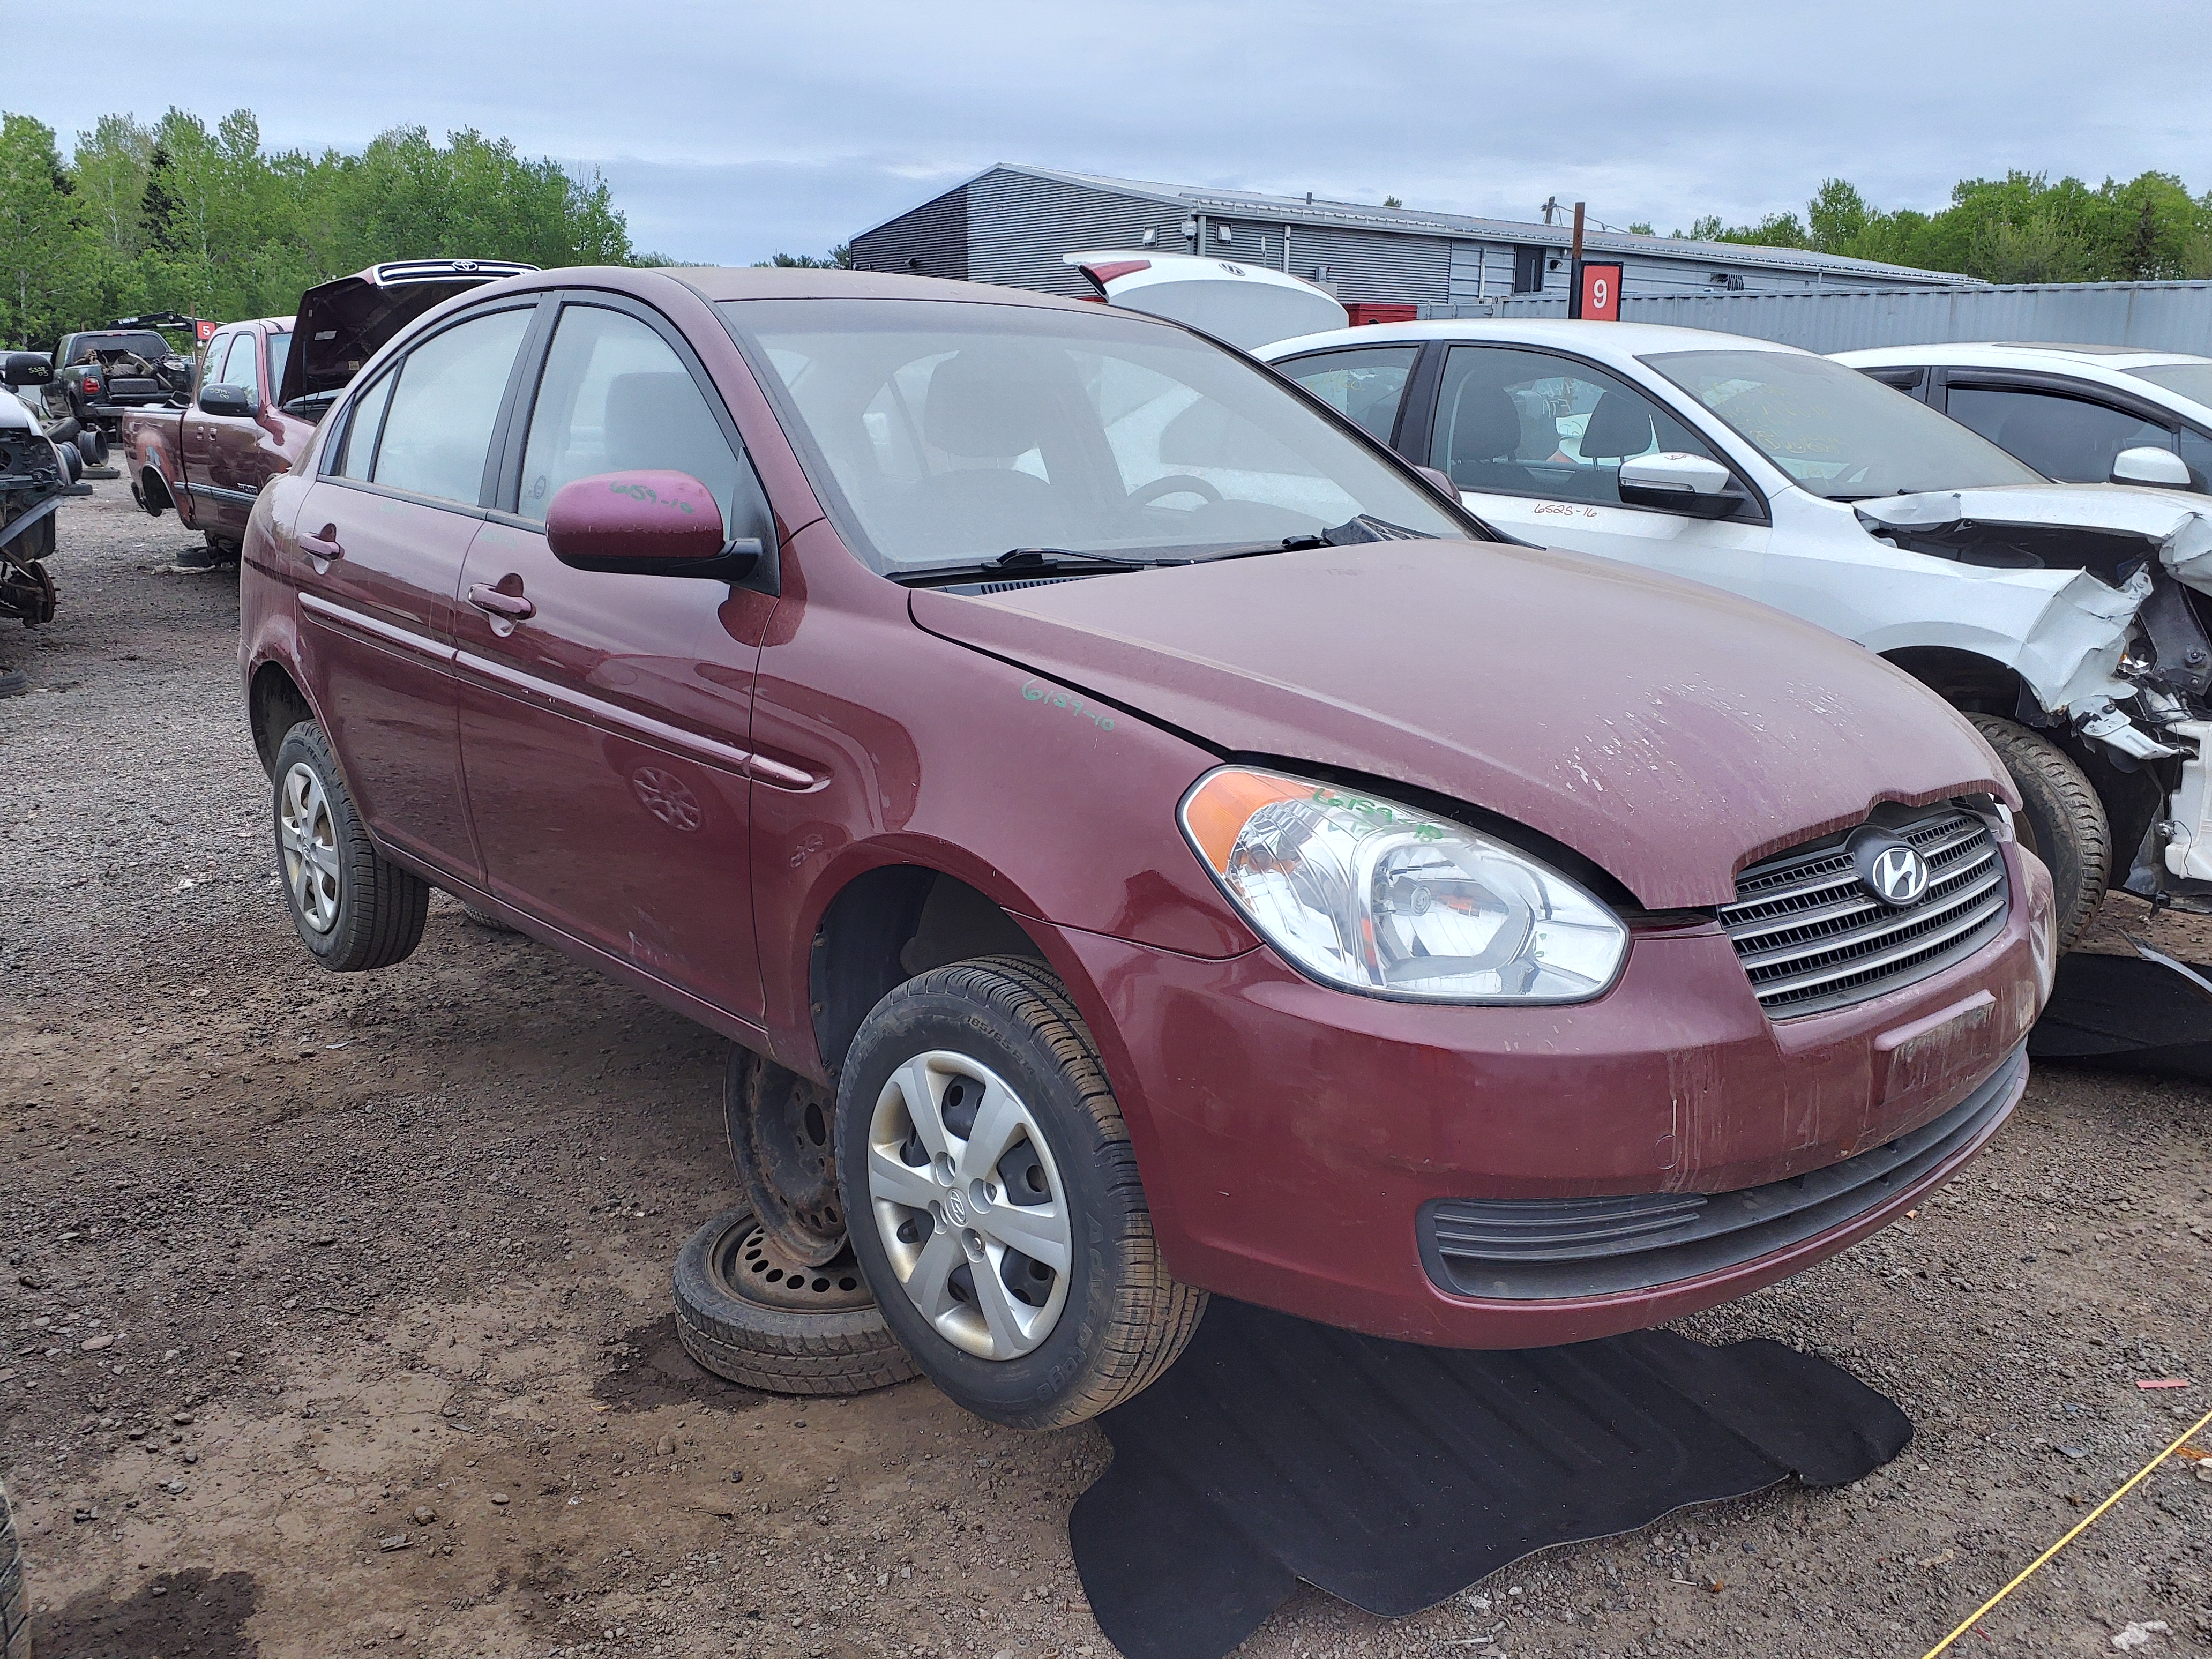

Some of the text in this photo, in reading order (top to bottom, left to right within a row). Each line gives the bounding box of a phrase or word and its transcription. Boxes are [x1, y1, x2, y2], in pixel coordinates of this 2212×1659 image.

[1593, 279, 1609, 309] 9
[203, 325, 210, 335] 5
[1021, 678, 1115, 731] 6159-10
